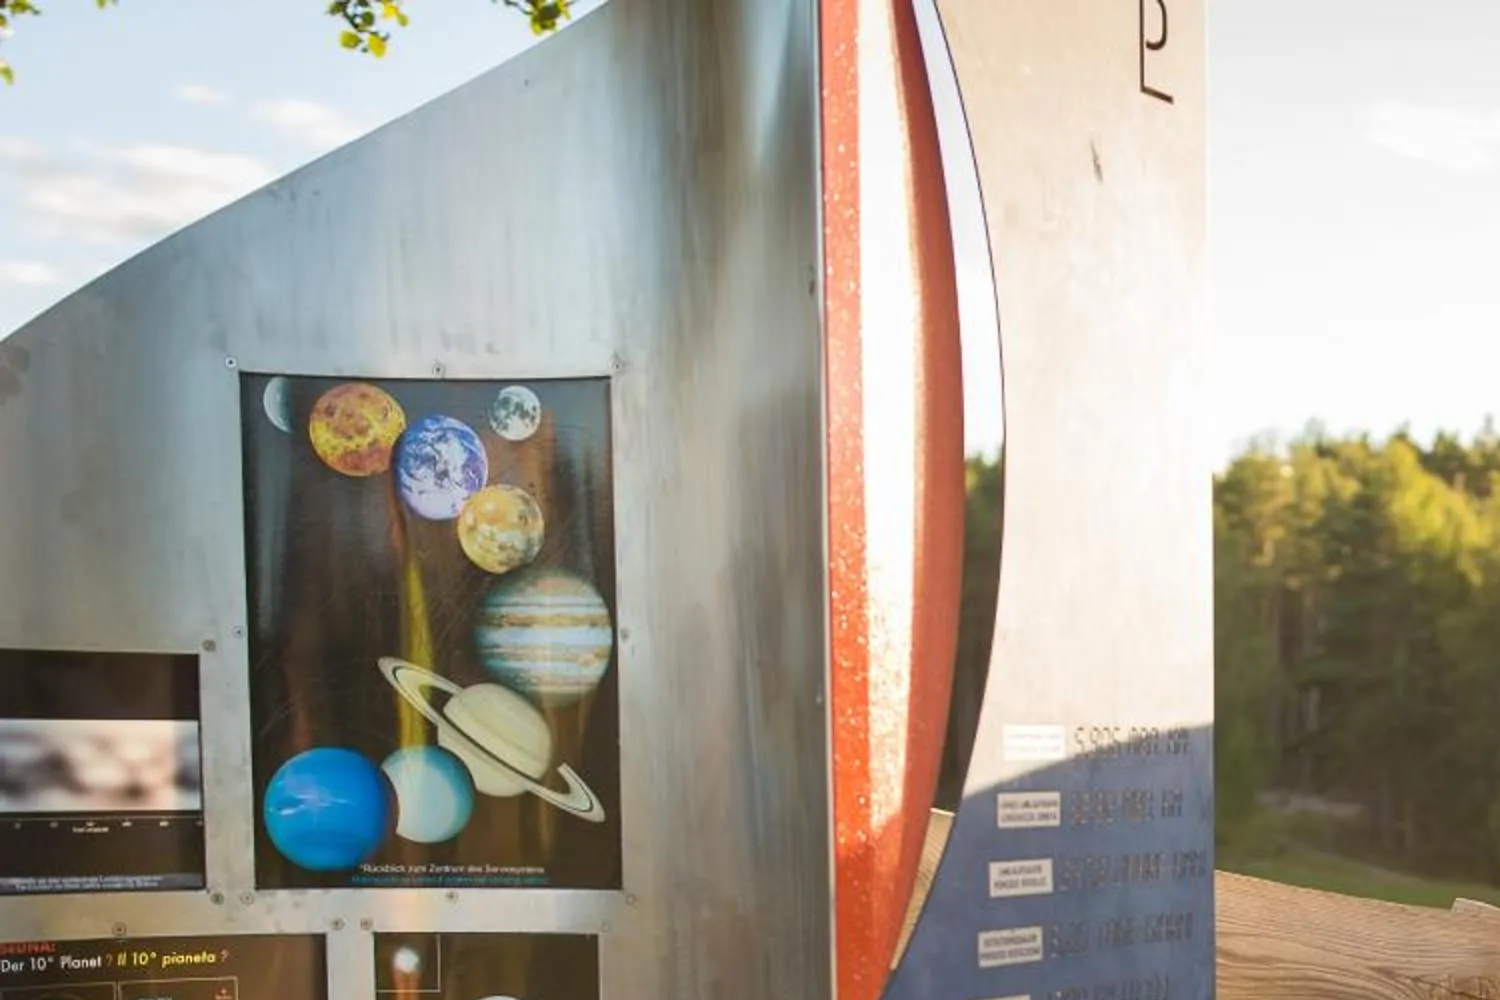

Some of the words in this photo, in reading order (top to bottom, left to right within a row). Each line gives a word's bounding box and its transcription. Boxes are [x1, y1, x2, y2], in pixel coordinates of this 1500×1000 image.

[1, 959, 25, 973] Der
[60, 954, 102, 970] Planet
[161, 951, 217, 969] pianeta
